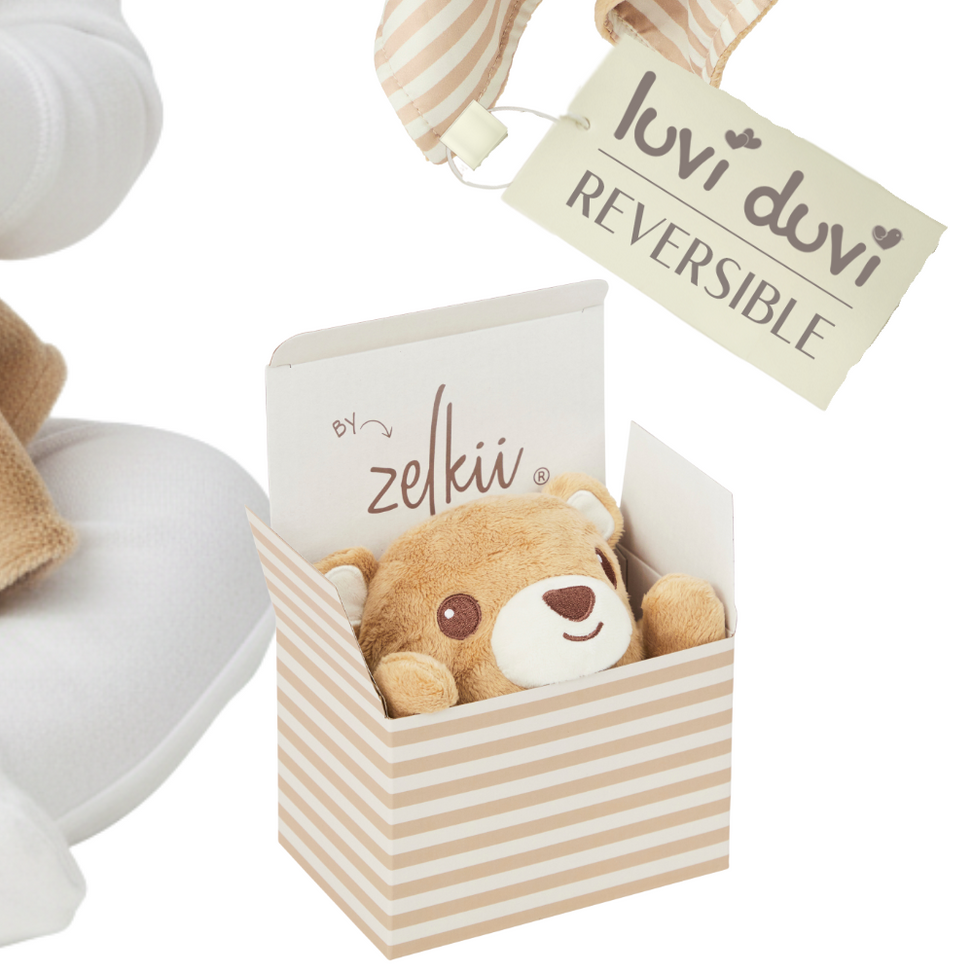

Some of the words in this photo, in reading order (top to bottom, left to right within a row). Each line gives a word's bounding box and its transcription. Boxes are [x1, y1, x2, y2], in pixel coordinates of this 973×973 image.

[613, 70, 762, 192] luvi
[744, 169, 904, 288] duvi
[565, 169, 836, 360] REVERSIBLE
[331, 411, 357, 438] BY
[367, 383, 524, 516] zelkii
